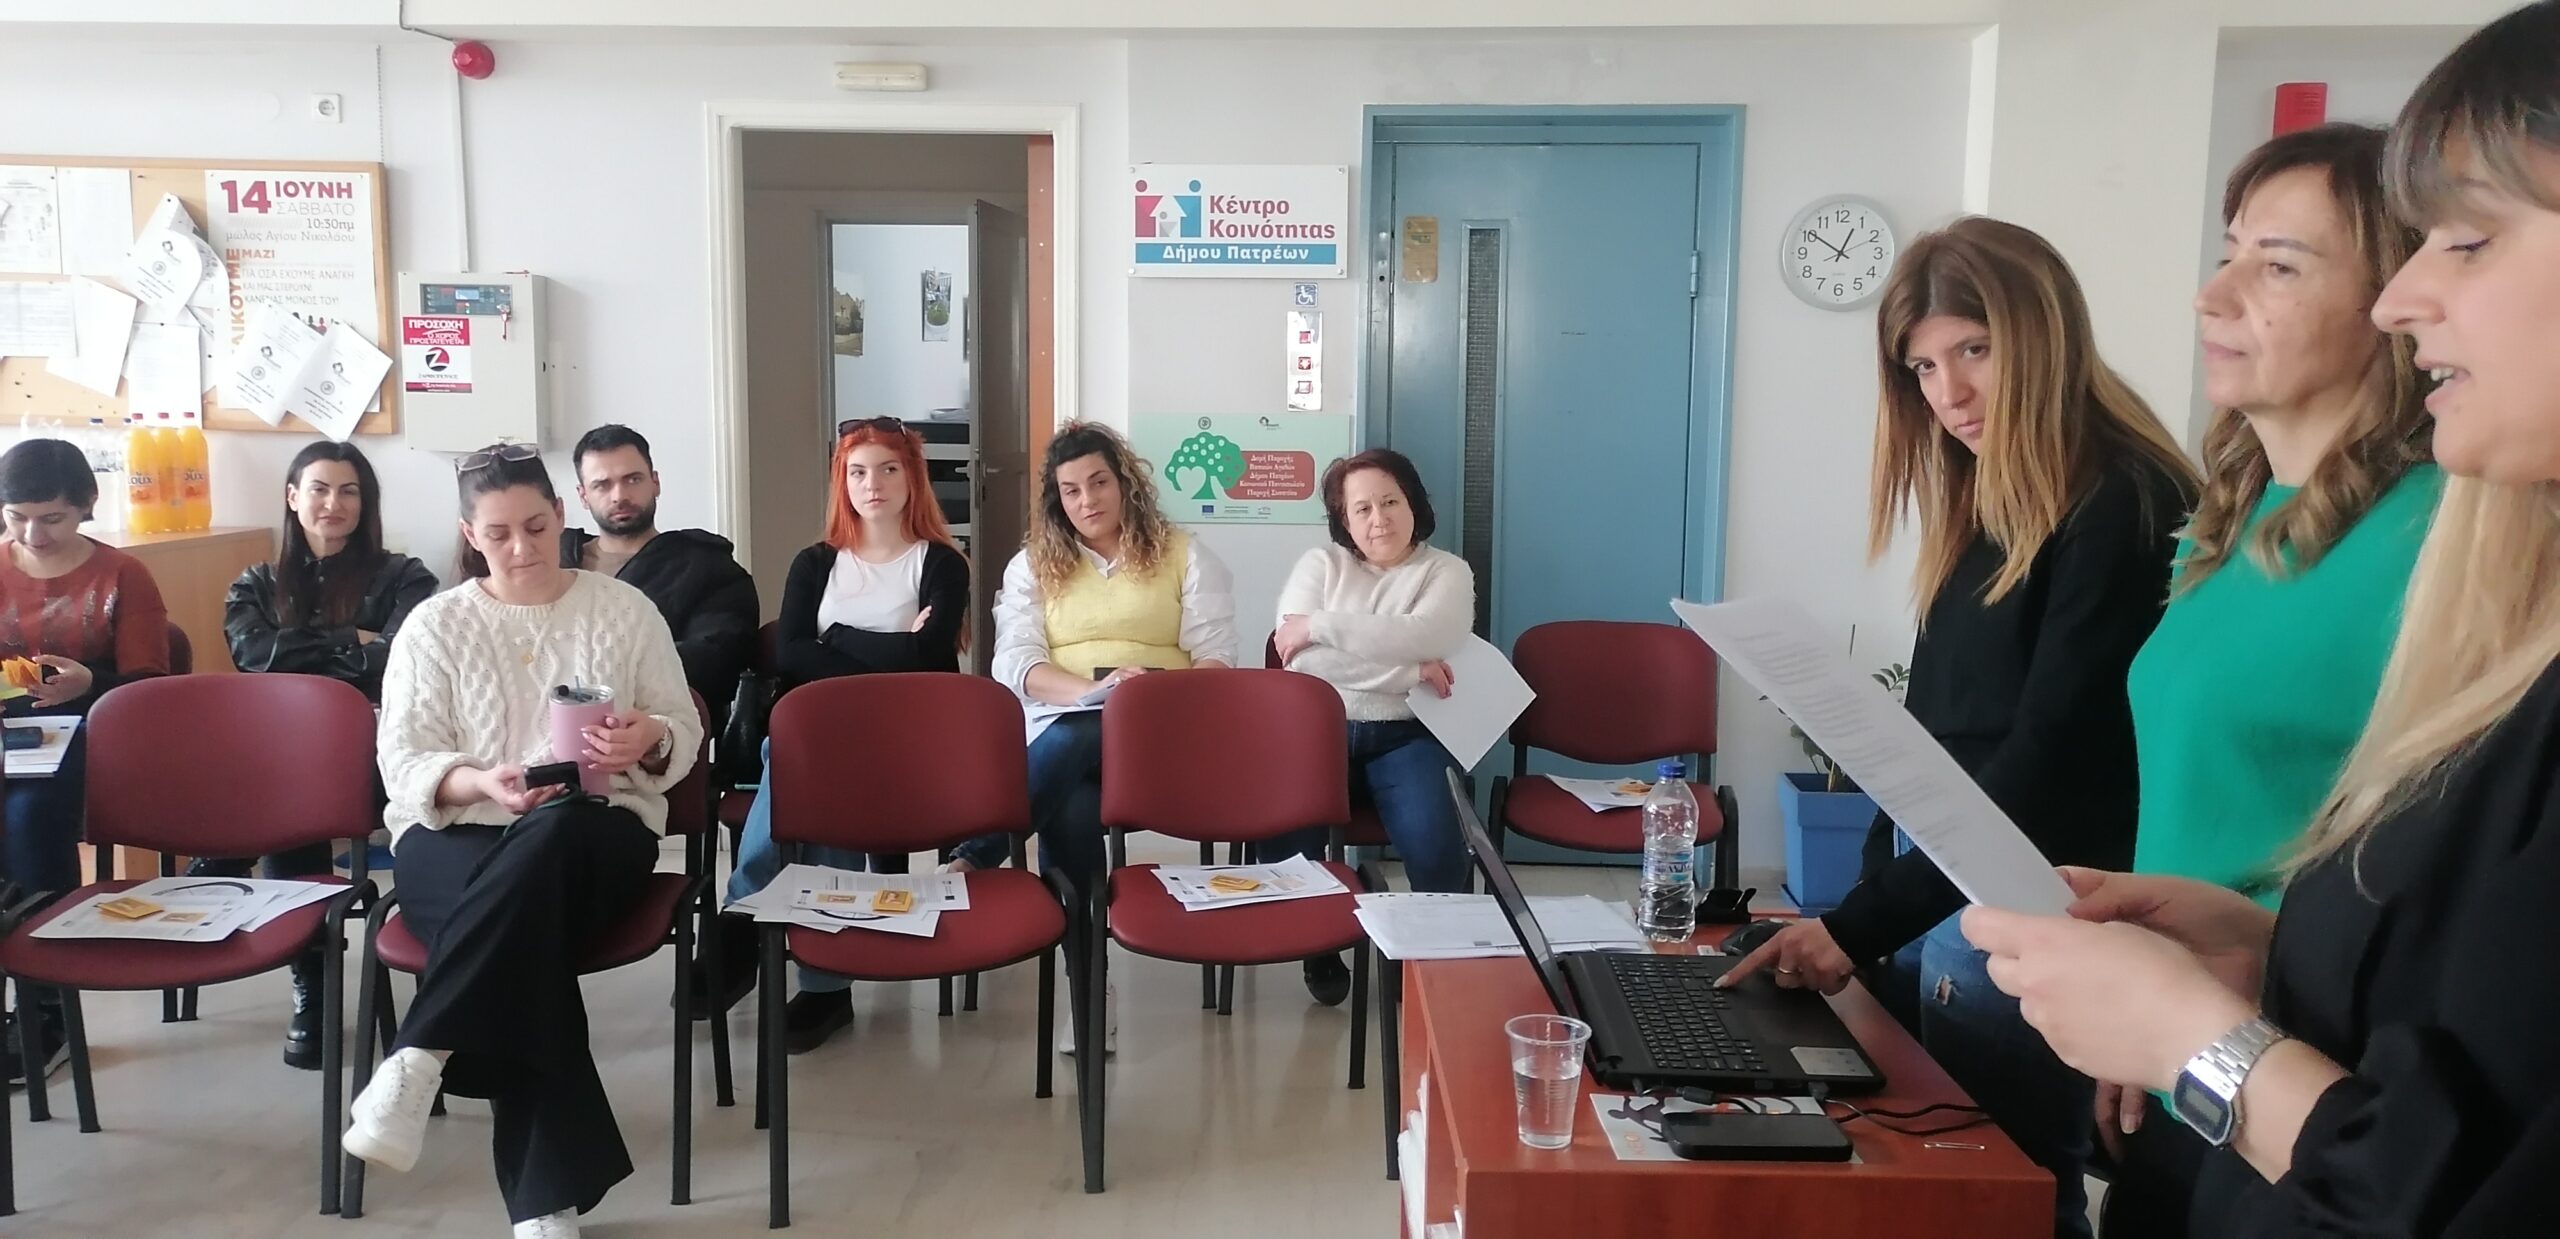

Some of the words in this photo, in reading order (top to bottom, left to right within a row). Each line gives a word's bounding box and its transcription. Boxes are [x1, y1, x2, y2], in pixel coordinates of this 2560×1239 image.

[220, 180, 272, 214] 14
[275, 181, 353, 199] ΙΟΥΝΗ
[276, 202, 355, 216] ΣΑΒΒΑΤΟ
[1209, 195, 1290, 219] Κέντρο
[1817, 216, 1829, 229] 11
[1835, 209, 1851, 224] 12
[1859, 216, 1864, 229] 1
[306, 218, 355, 231] 10:30πμ
[1209, 219, 1336, 239] Κοινότητας
[1802, 229, 1817, 243] 10
[1869, 229, 1880, 243] 2
[241, 249, 275, 258] ΜΑΖΙ
[1162, 245, 1221, 263] Δήμου
[1227, 245, 1309, 263] Πατρέων
[1797, 246, 1808, 260] 9
[1873, 246, 1883, 260] 3
[1801, 265, 1813, 279] 8
[1866, 265, 1877, 279] 4
[1816, 277, 1827, 290] 7
[1833, 283, 1844, 297] 6
[1852, 277, 1863, 291] 5
[409, 320, 463, 329] ΠΡΟΣΟΧΗ
